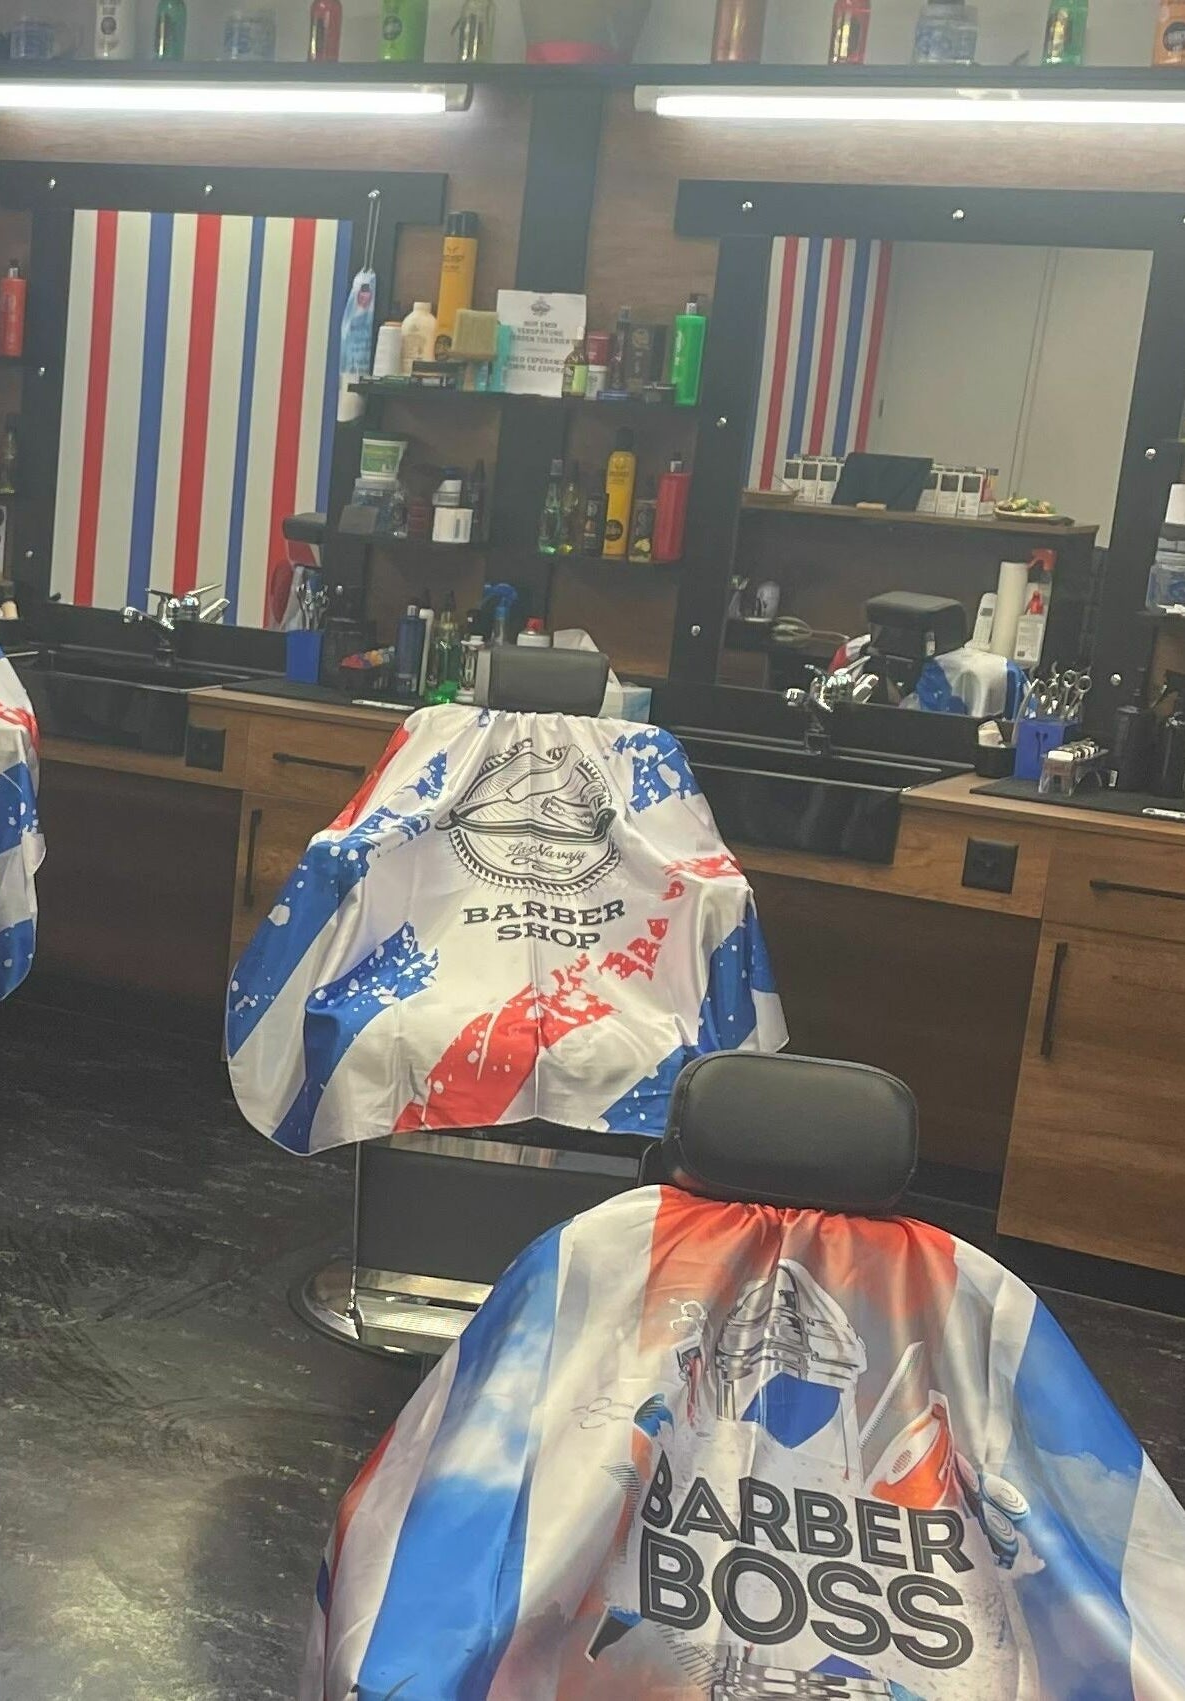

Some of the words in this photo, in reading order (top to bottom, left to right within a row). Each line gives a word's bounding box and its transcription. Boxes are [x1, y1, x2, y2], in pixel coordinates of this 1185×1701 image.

[463, 899, 626, 925] BARBER
[496, 922, 601, 950] SHOP
[640, 1449, 975, 1574] BARBER
[639, 1527, 975, 1671] BOSS
